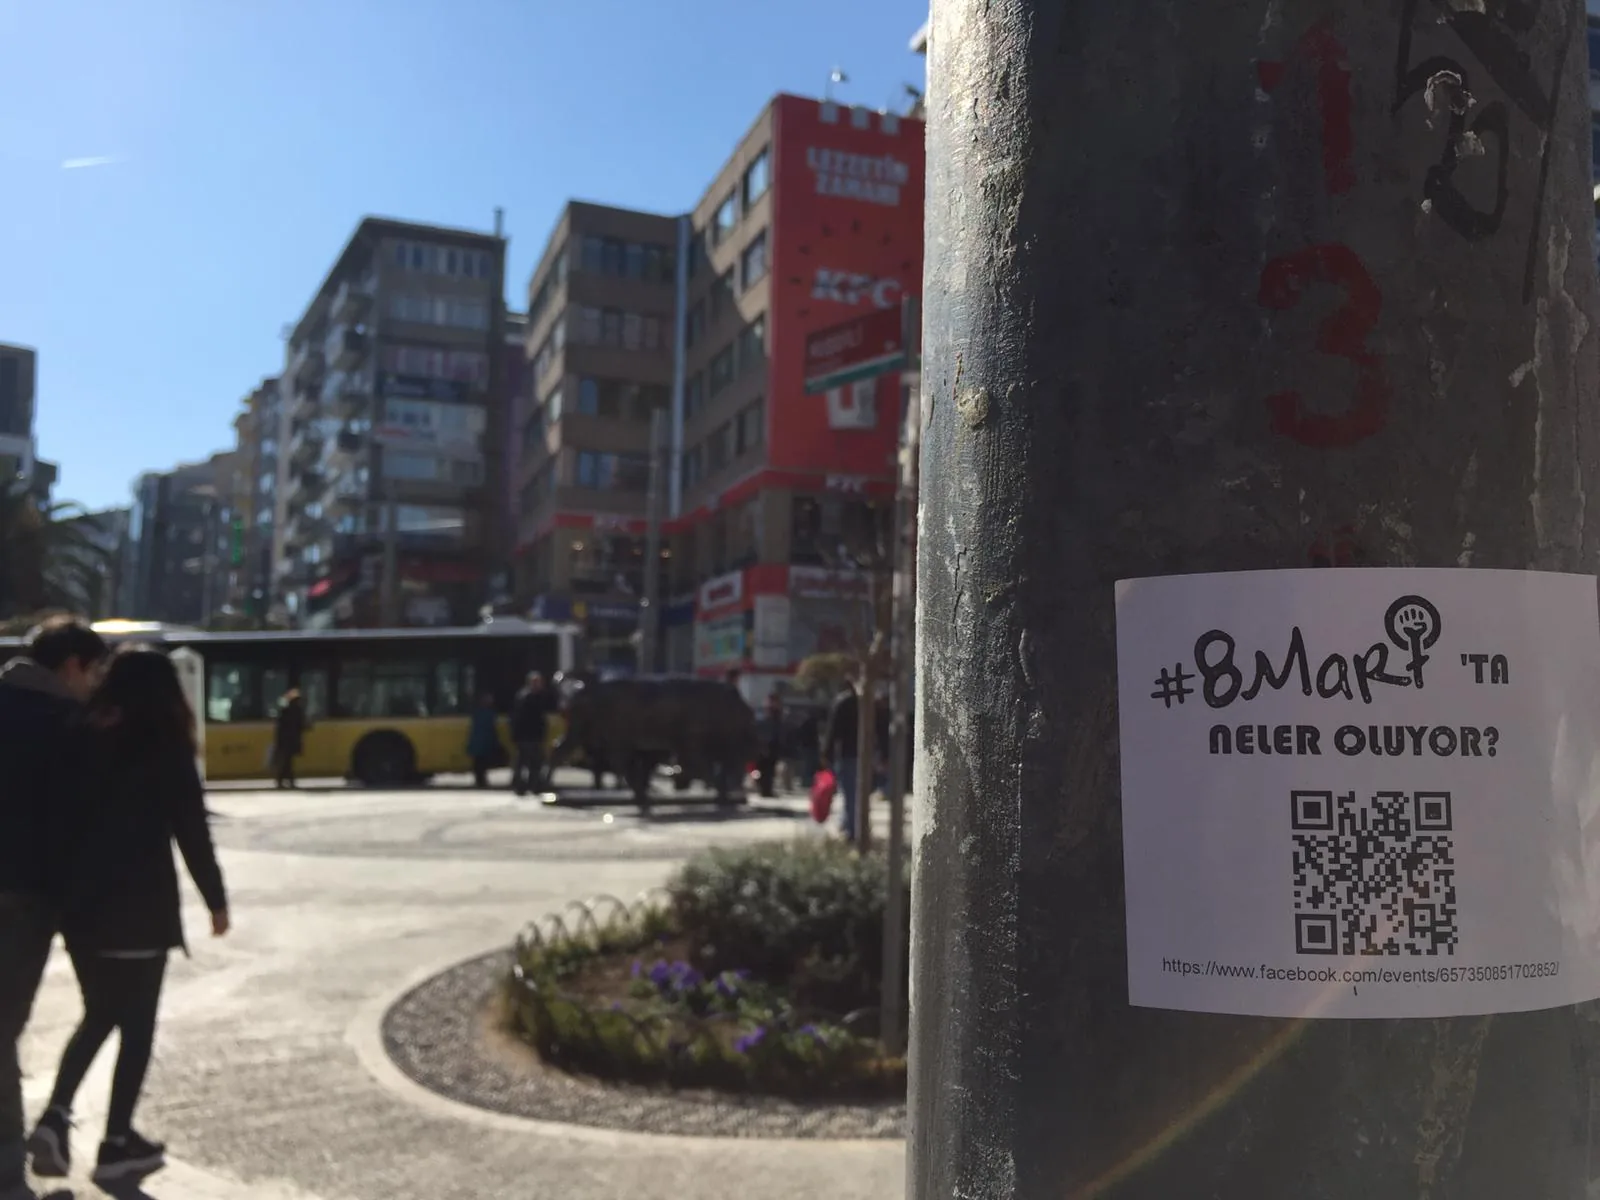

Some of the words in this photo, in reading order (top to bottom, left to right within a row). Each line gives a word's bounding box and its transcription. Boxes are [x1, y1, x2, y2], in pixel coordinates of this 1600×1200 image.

[811, 267, 900, 309] KFC
[1258, 241, 1393, 450] 3
[1209, 724, 1322, 755] NELER
[1333, 724, 1500, 756] OLUYOR?
[1162, 957, 1560, 984] https://www.facebook.com/events/657350851702852/
